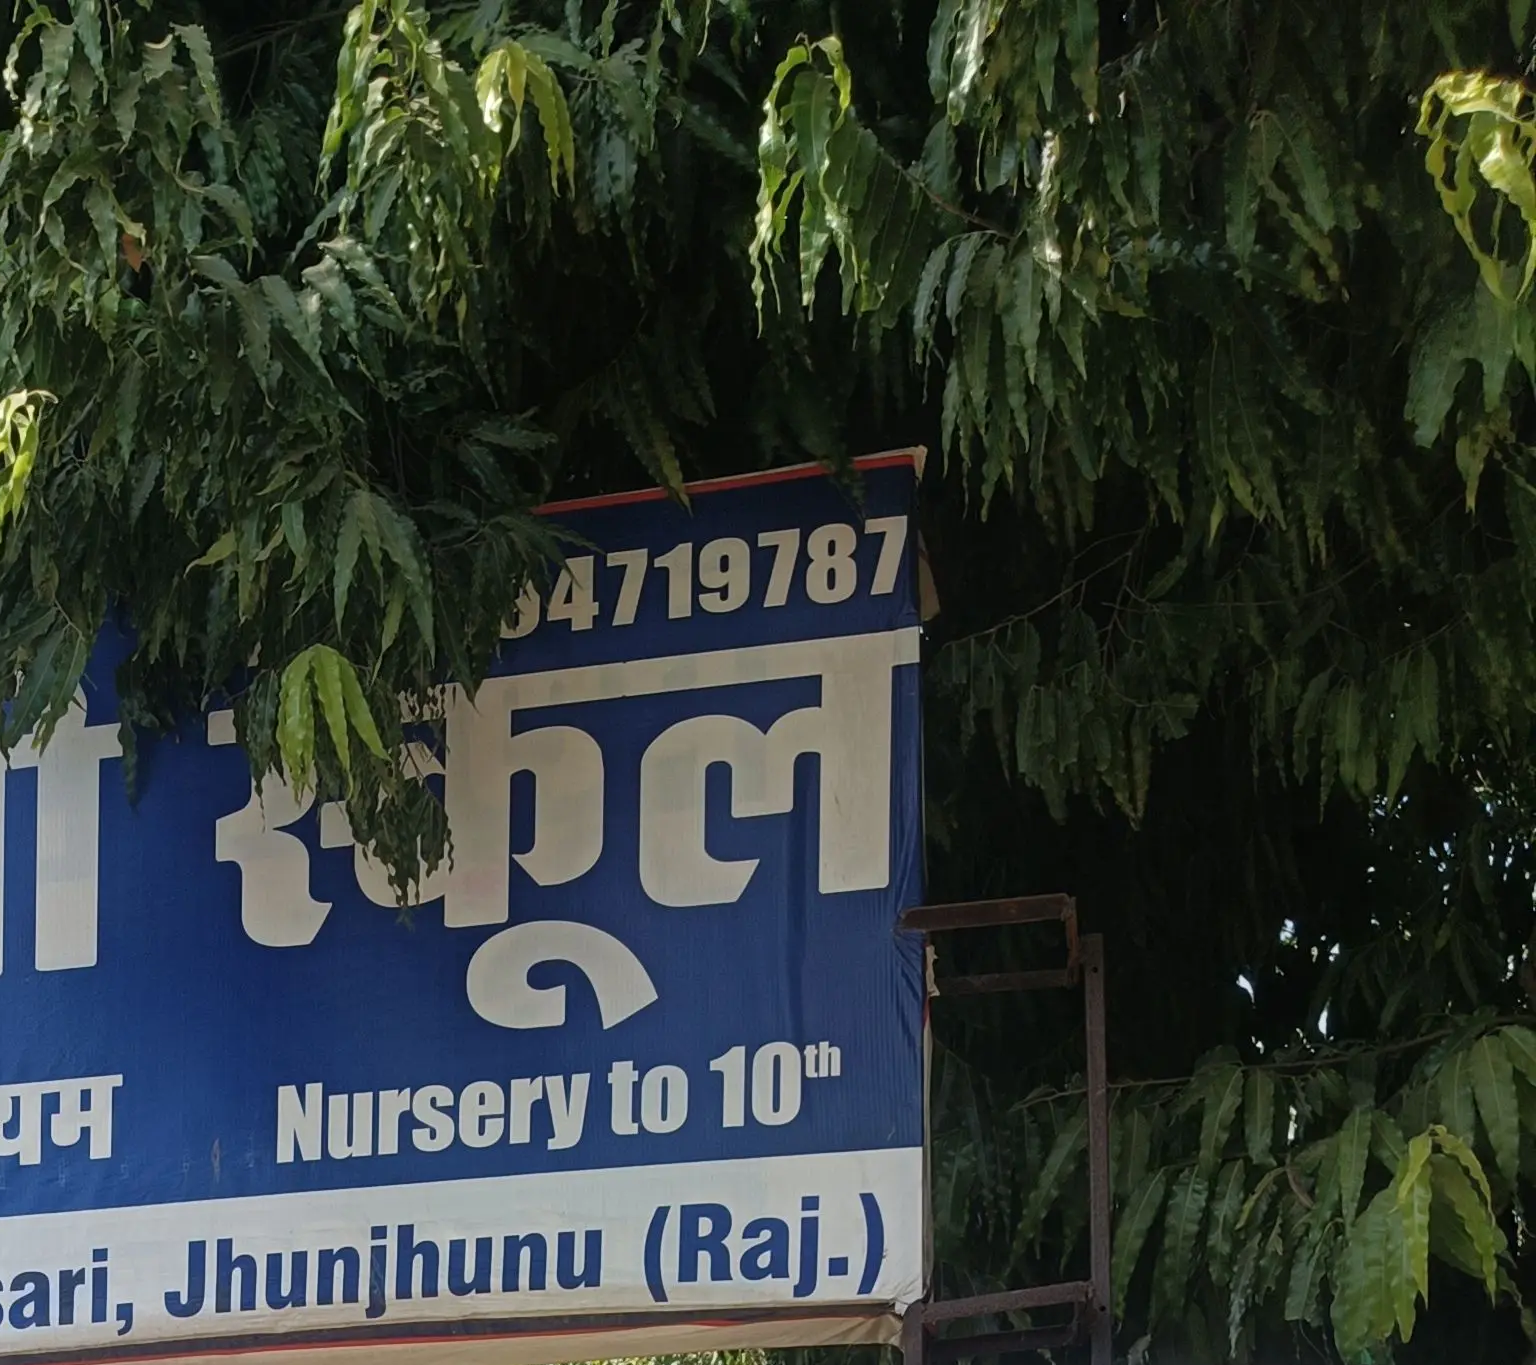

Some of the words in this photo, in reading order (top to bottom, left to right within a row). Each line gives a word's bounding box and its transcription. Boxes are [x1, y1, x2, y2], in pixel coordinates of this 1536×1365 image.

[276, 1072, 591, 1164] Nursery
[607, 1060, 689, 1136] to
[709, 1041, 841, 1128] 10th
[164, 1223, 603, 1319] Jhunjhunu
[643, 1192, 885, 1300] (Raj.)
